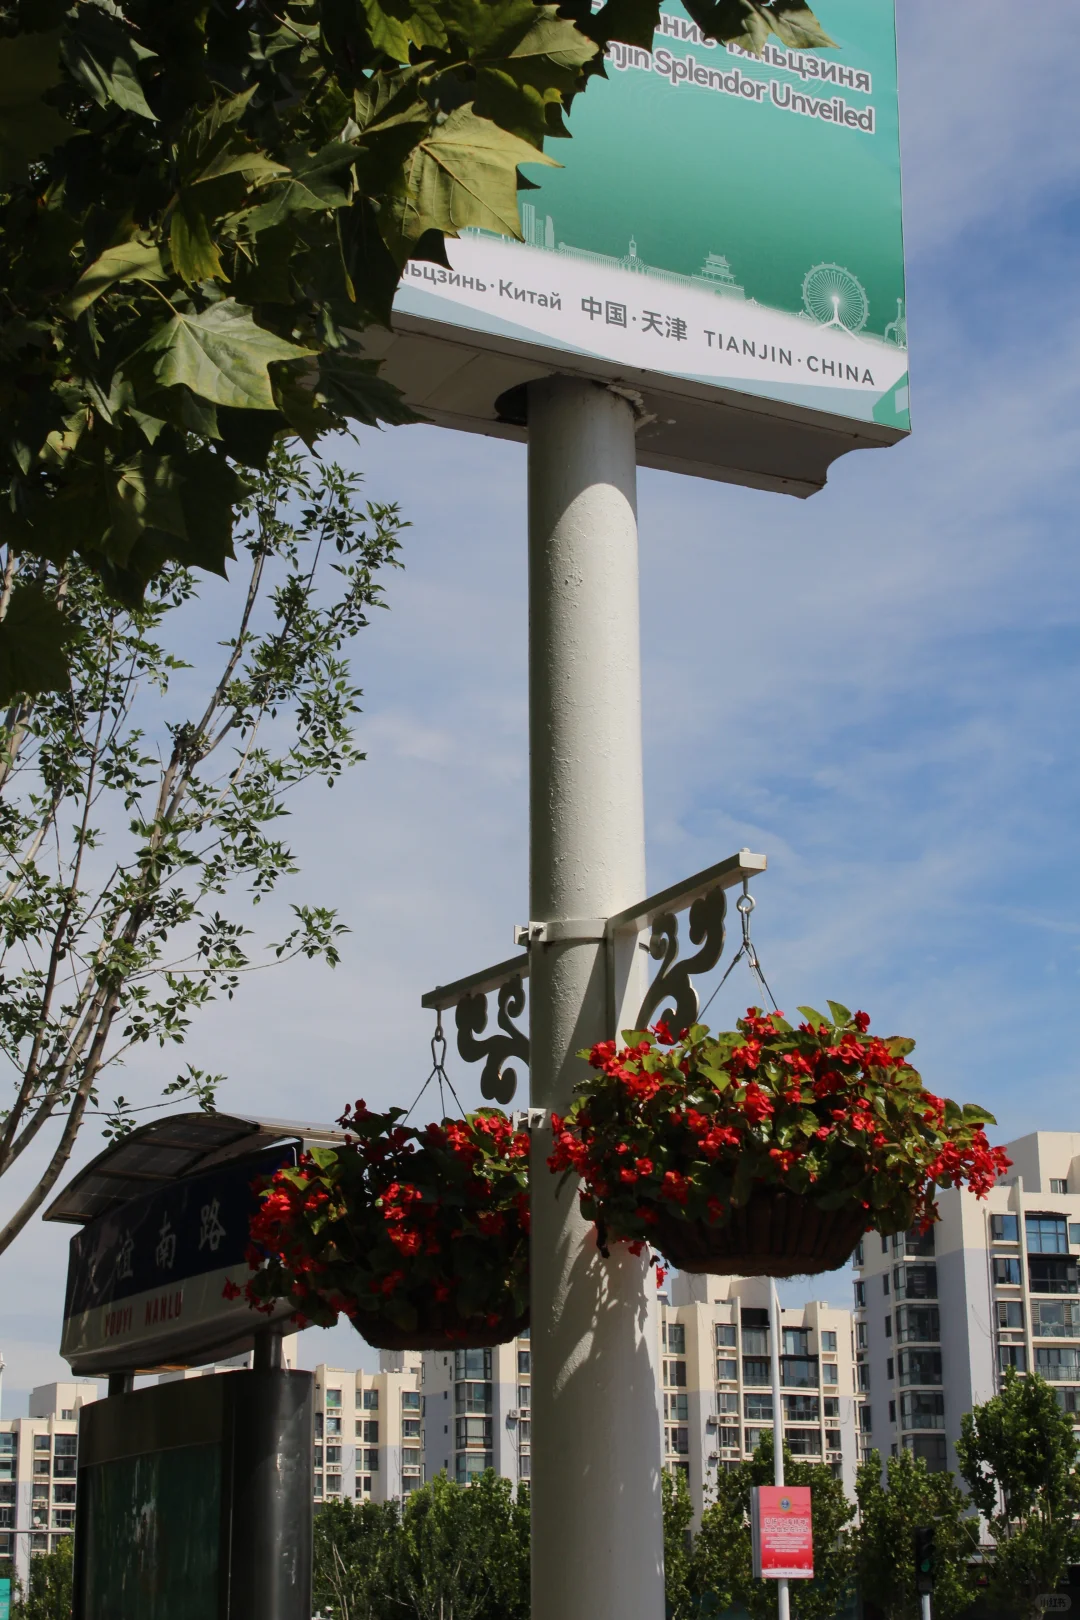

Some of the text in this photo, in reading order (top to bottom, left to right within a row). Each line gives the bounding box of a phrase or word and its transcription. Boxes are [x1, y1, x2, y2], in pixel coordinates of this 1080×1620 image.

[656, 51, 766, 100] Splendor
[771, 83, 874, 132] Unveiled
[581, 296, 688, 342] 中国·天津
[104, 1290, 183, 1338] YOUYI NANLU
